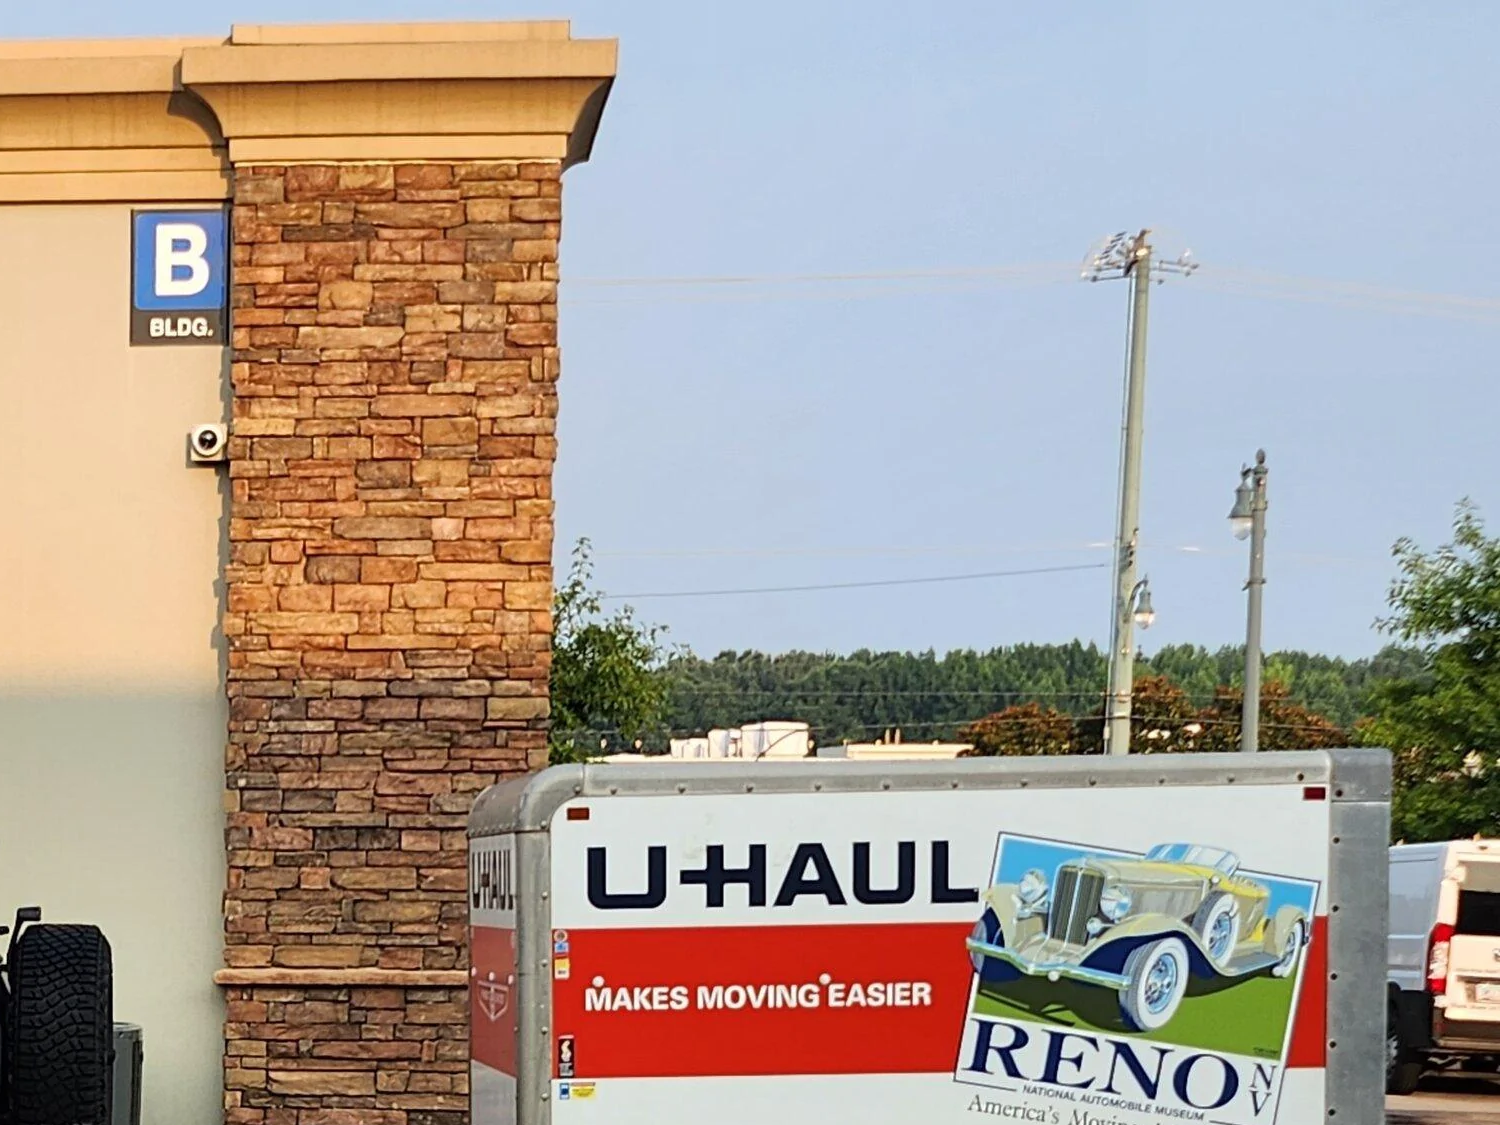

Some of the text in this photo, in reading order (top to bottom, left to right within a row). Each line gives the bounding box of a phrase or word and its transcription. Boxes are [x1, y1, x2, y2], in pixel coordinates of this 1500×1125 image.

[155, 223, 209, 297] B
[149, 316, 213, 337] BLDG.
[587, 840, 979, 909] U-HAUL
[584, 982, 932, 1011] MAKES MOVING EASIER
[961, 1017, 1239, 1110] RENO
[967, 1094, 1060, 1125] America's
[1022, 1084, 1205, 1122] NATIONAL AUTOMOBILE MUSEUM
